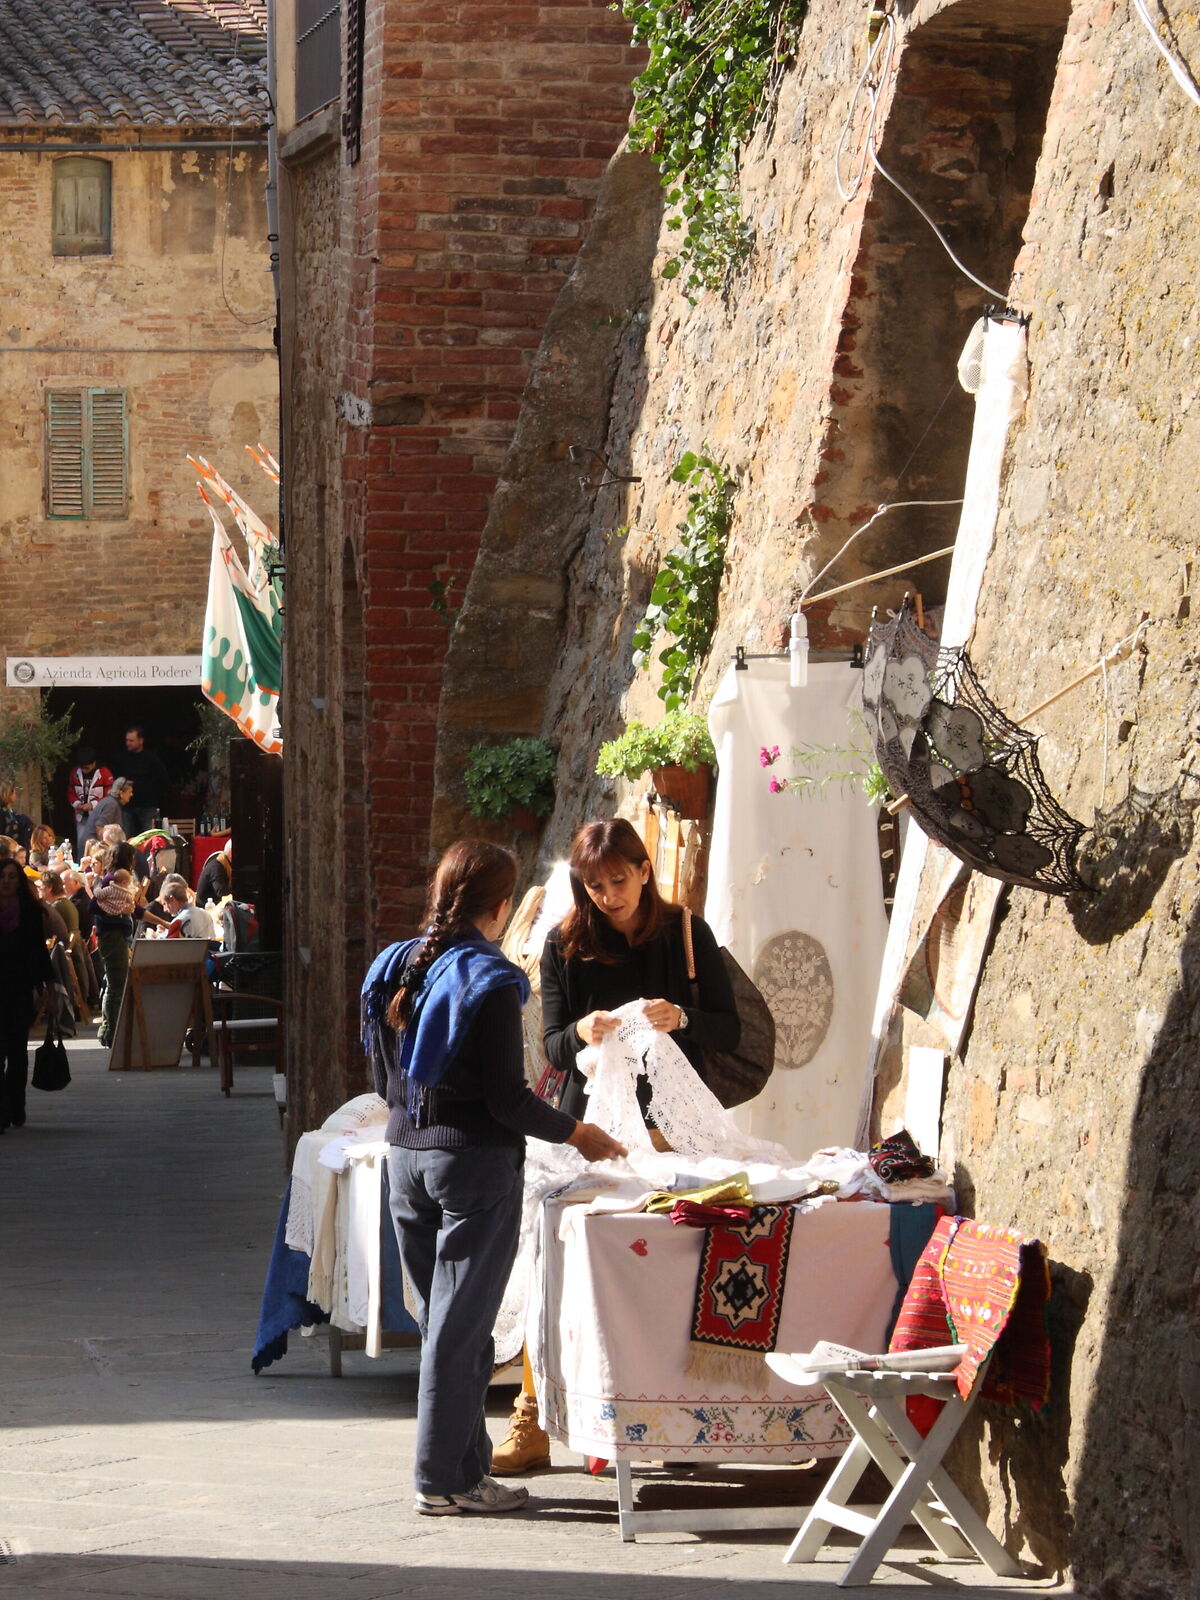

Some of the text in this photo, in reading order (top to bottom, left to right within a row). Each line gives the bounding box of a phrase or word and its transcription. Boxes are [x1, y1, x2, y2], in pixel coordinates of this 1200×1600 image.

[42, 666, 92, 679] Azienda
[96, 666, 146, 681] Agricola
[151, 665, 192, 679] Podere
